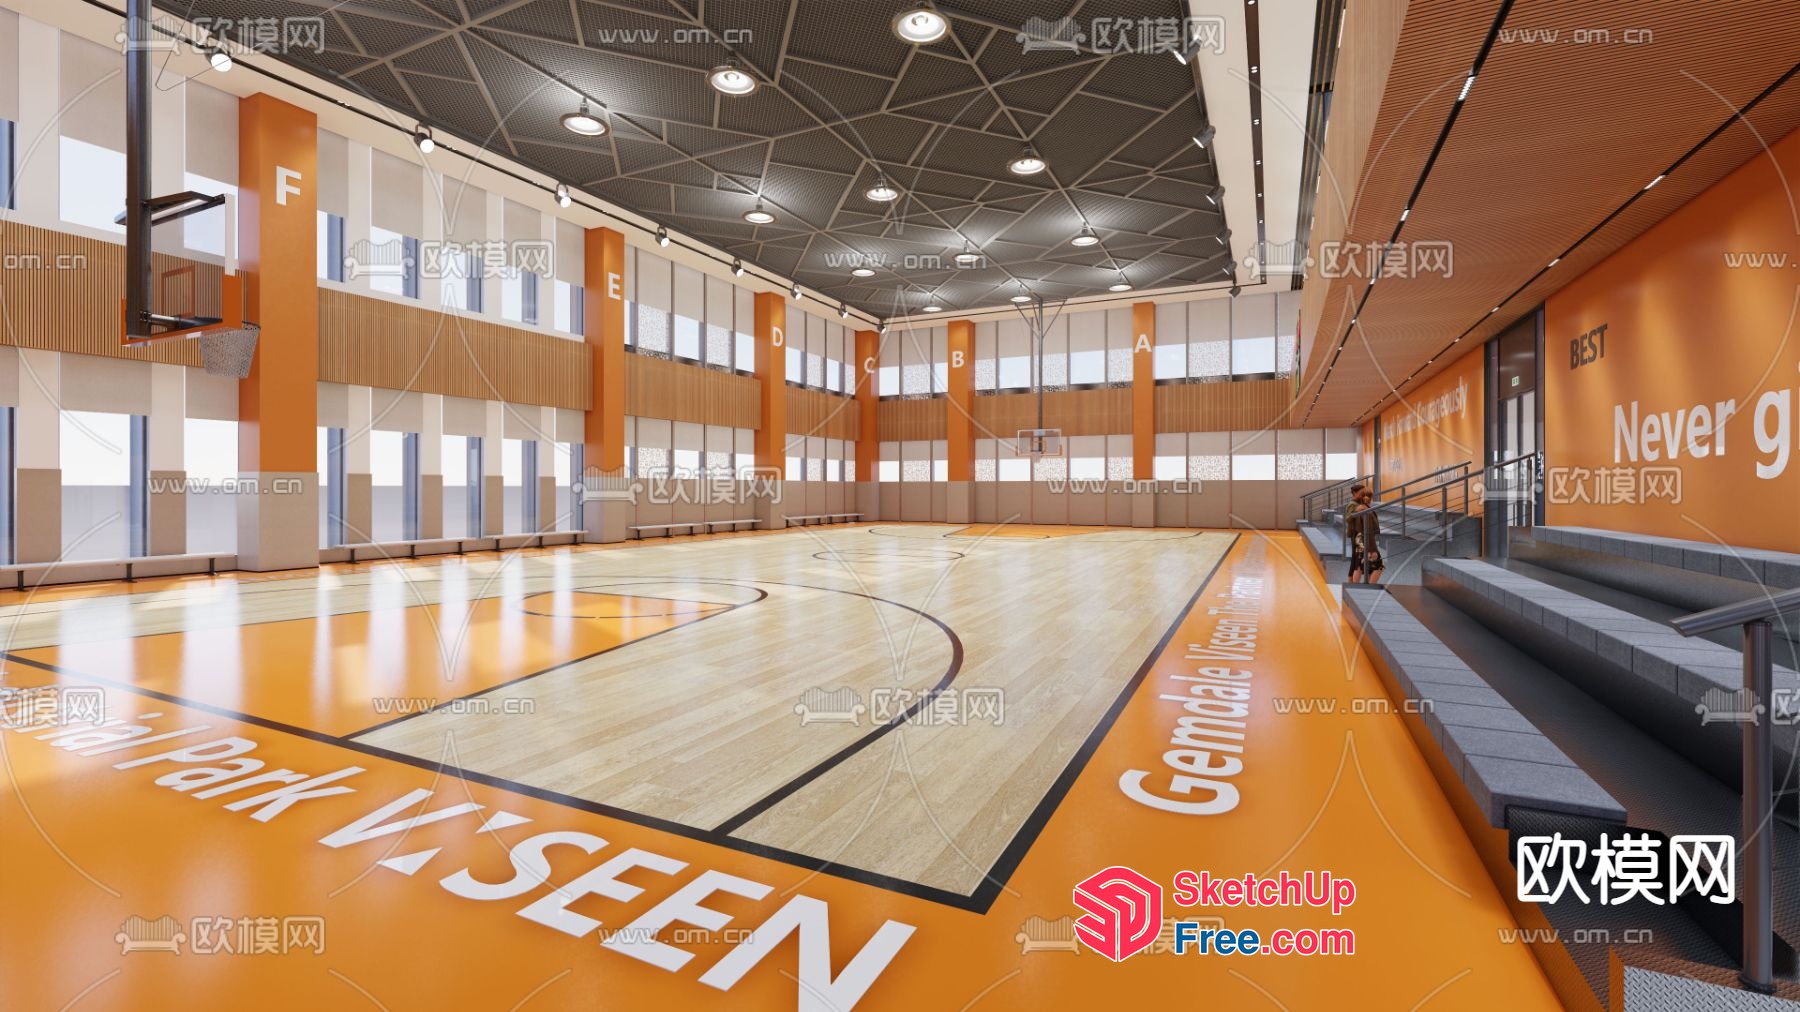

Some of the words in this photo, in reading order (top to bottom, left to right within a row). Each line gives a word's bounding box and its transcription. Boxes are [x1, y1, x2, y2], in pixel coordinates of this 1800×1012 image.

[276, 166, 302, 206] F
[607, 272, 621, 300] E
[772, 326, 784, 347] D
[1134, 334, 1153, 354] A
[1570, 323, 1608, 370] BEST
[864, 356, 875, 374] C
[951, 350, 965, 369] B
[1614, 399, 1736, 464] Never
[1184, 619, 1258, 661] Viseen
[1119, 667, 1253, 815] Gemdale
[112, 736, 367, 823] Park
